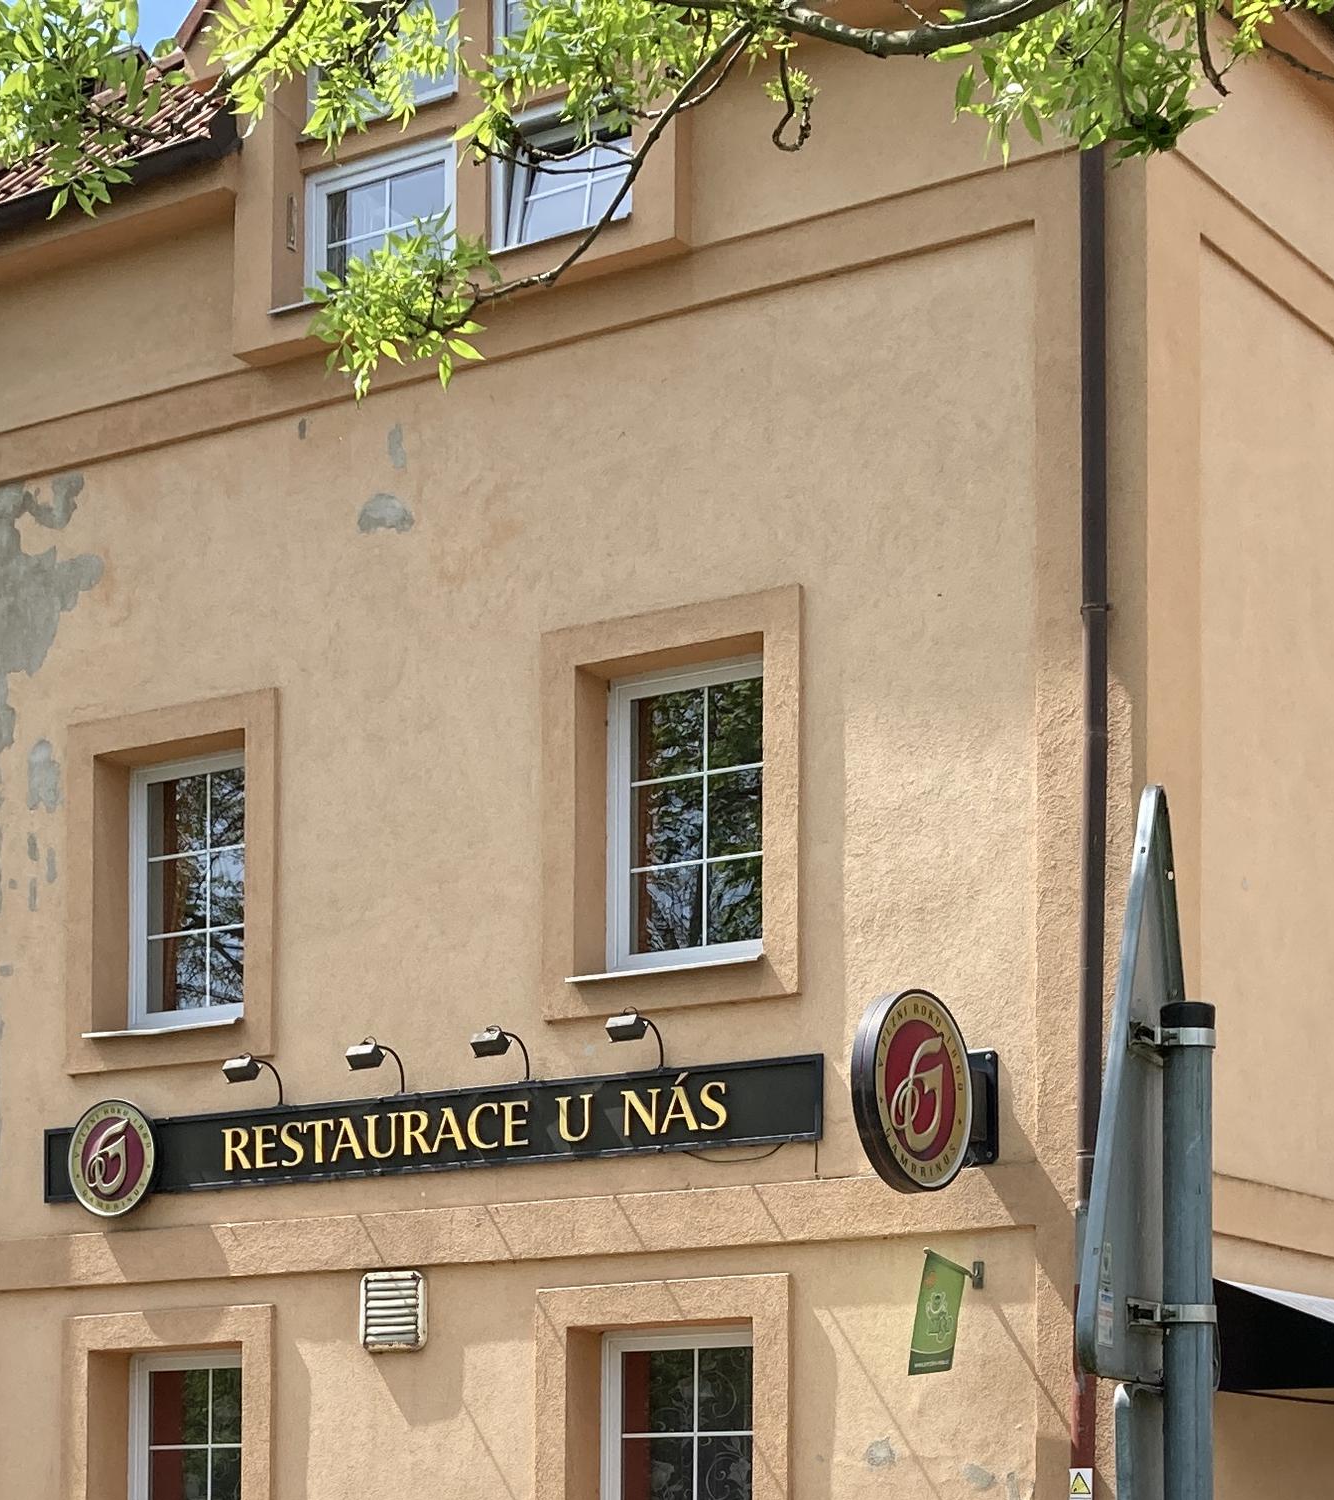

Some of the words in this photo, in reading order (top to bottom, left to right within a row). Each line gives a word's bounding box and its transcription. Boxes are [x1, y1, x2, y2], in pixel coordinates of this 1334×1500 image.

[221, 1100, 530, 1172] RESTAURACE
[555, 1094, 595, 1143] U
[619, 1072, 728, 1137] NÁS
